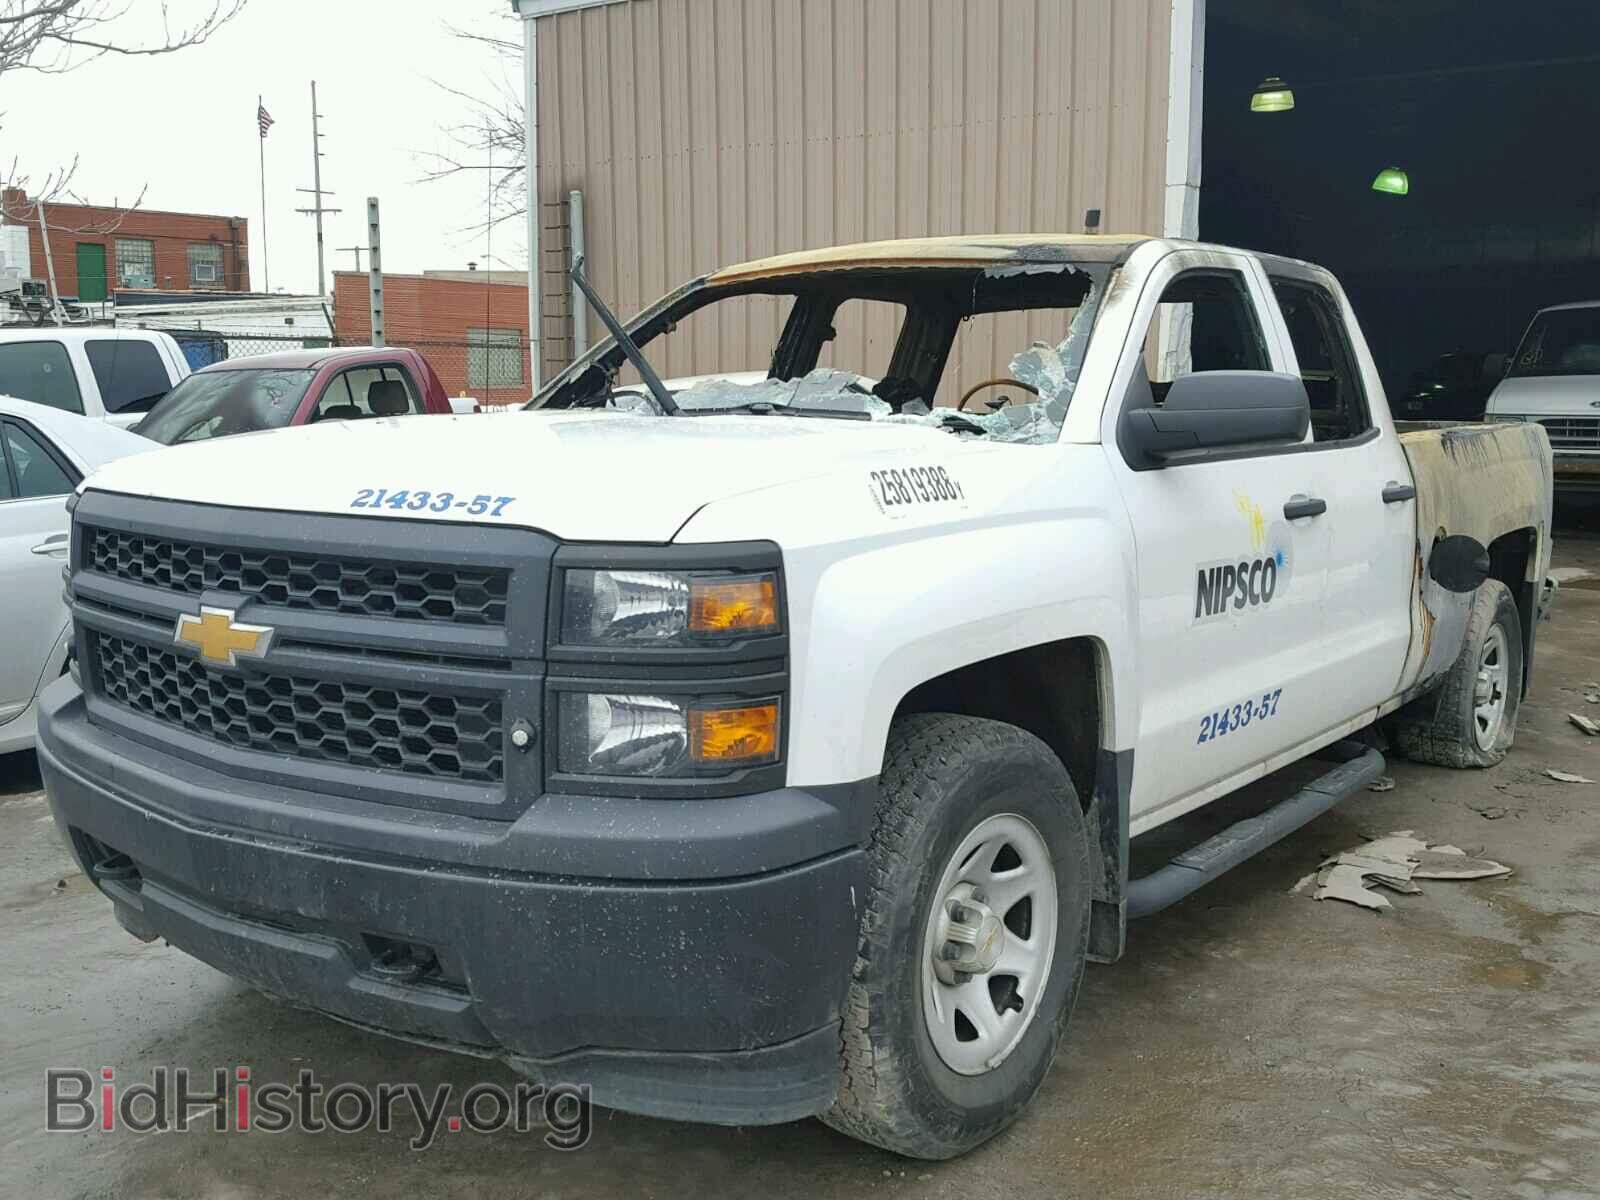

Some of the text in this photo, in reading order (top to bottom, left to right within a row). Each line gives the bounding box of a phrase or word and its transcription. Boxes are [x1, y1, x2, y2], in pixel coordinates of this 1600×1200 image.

[350, 488, 517, 517] 21433-57
[1195, 557, 1277, 619] NIPSCO
[1197, 688, 1282, 745] 21433-57
